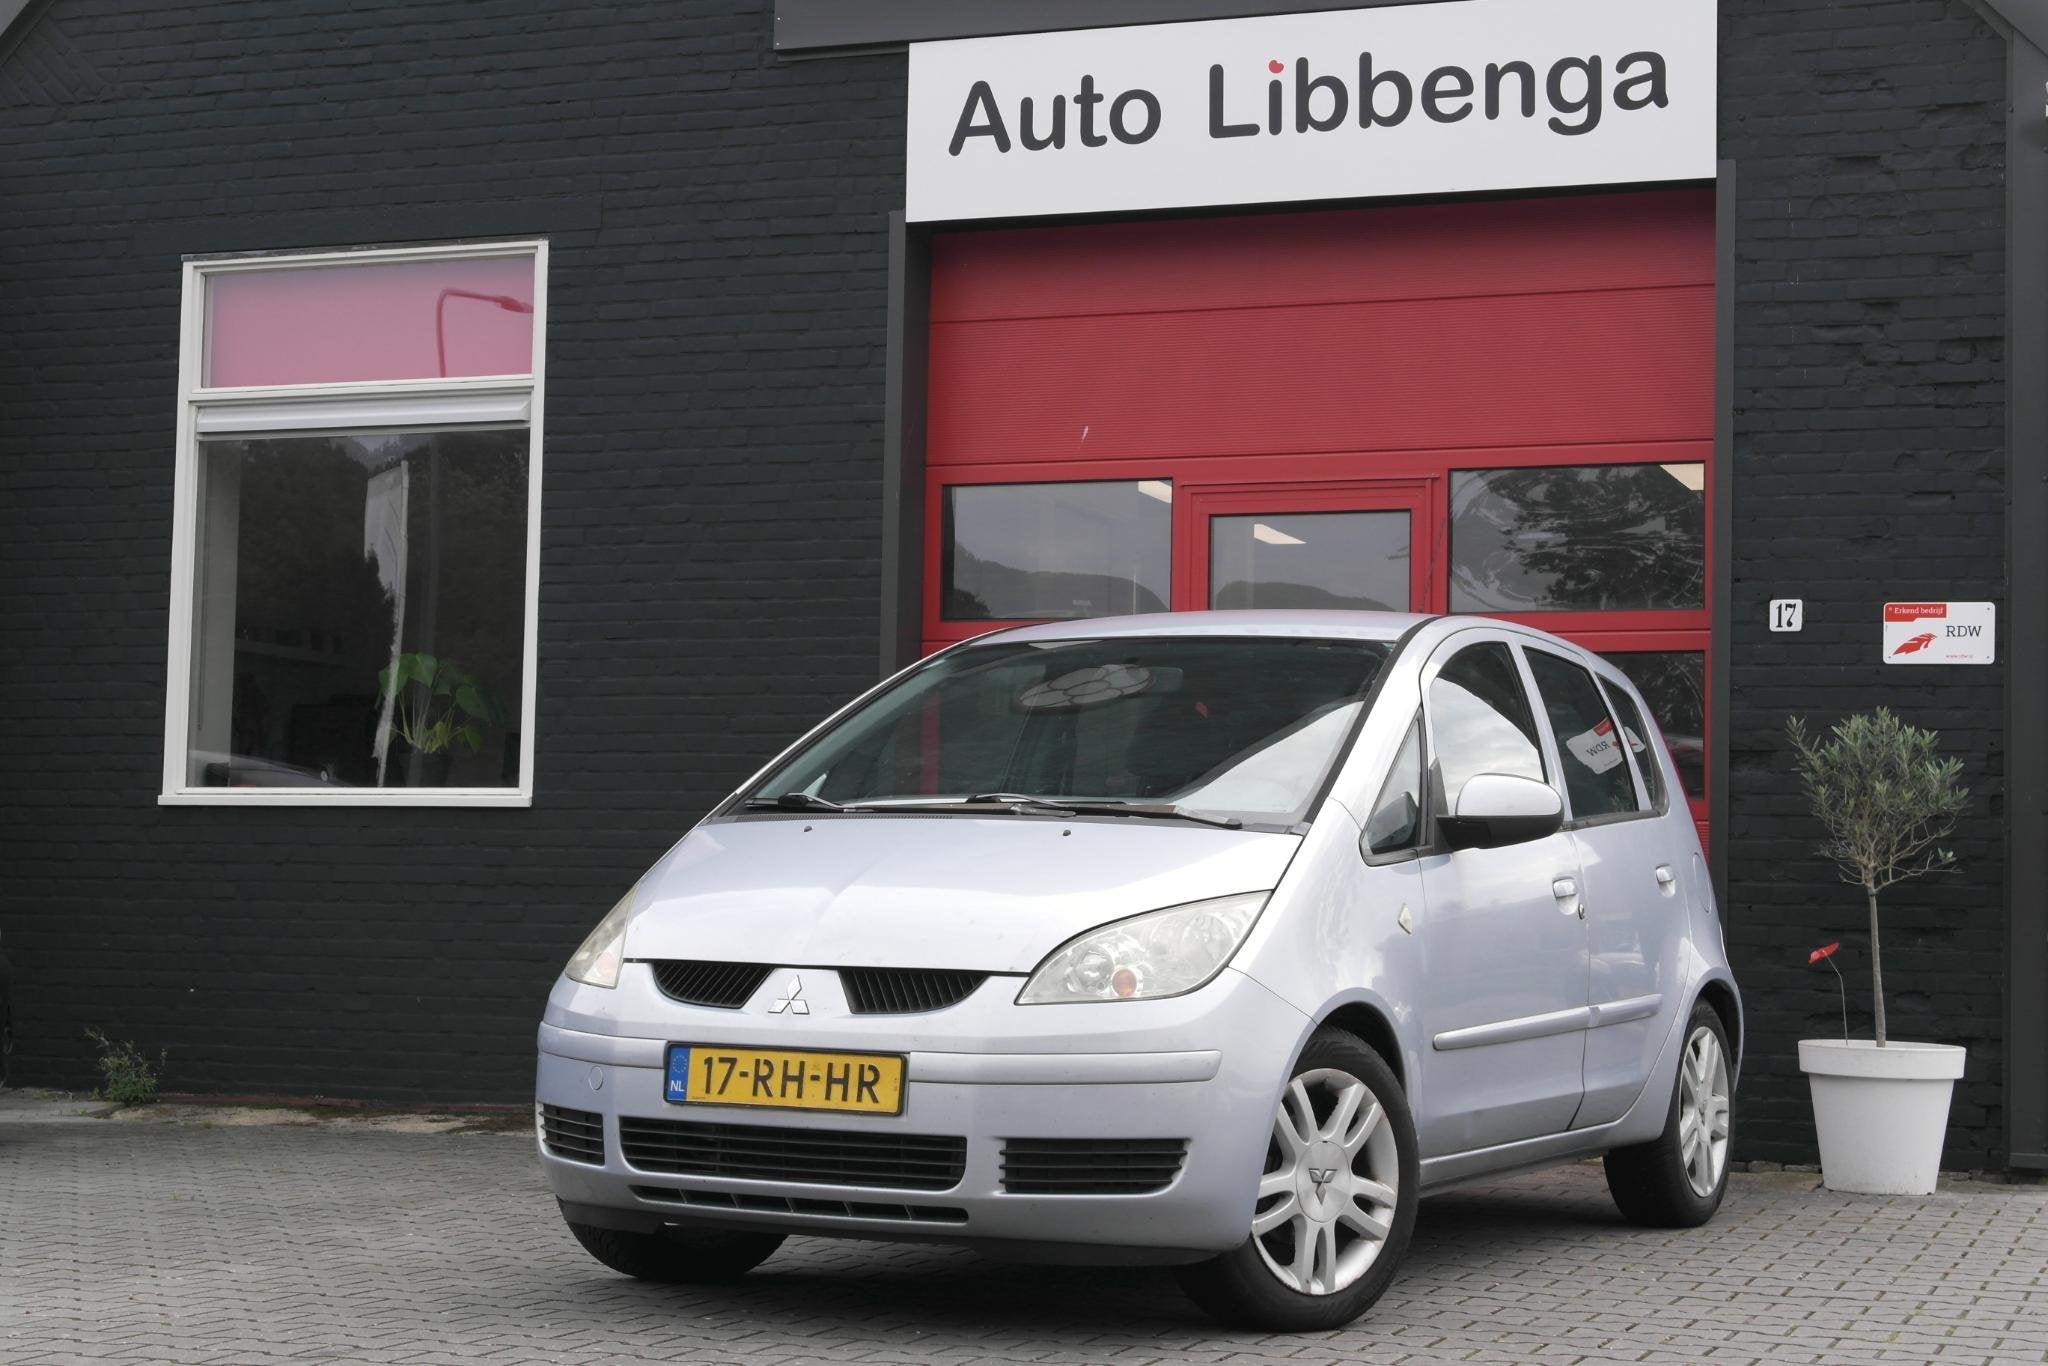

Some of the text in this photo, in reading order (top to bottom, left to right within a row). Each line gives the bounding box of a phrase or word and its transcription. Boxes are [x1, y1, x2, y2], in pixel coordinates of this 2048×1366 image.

[949, 51, 1669, 157] Auto Libbenga
[1775, 603, 1797, 628] 17
[1920, 607, 1943, 616] bedrijf
[1945, 625, 1982, 637] RDW
[670, 1079, 685, 1093] NL
[703, 1056, 881, 1104] 17-RH-HR
